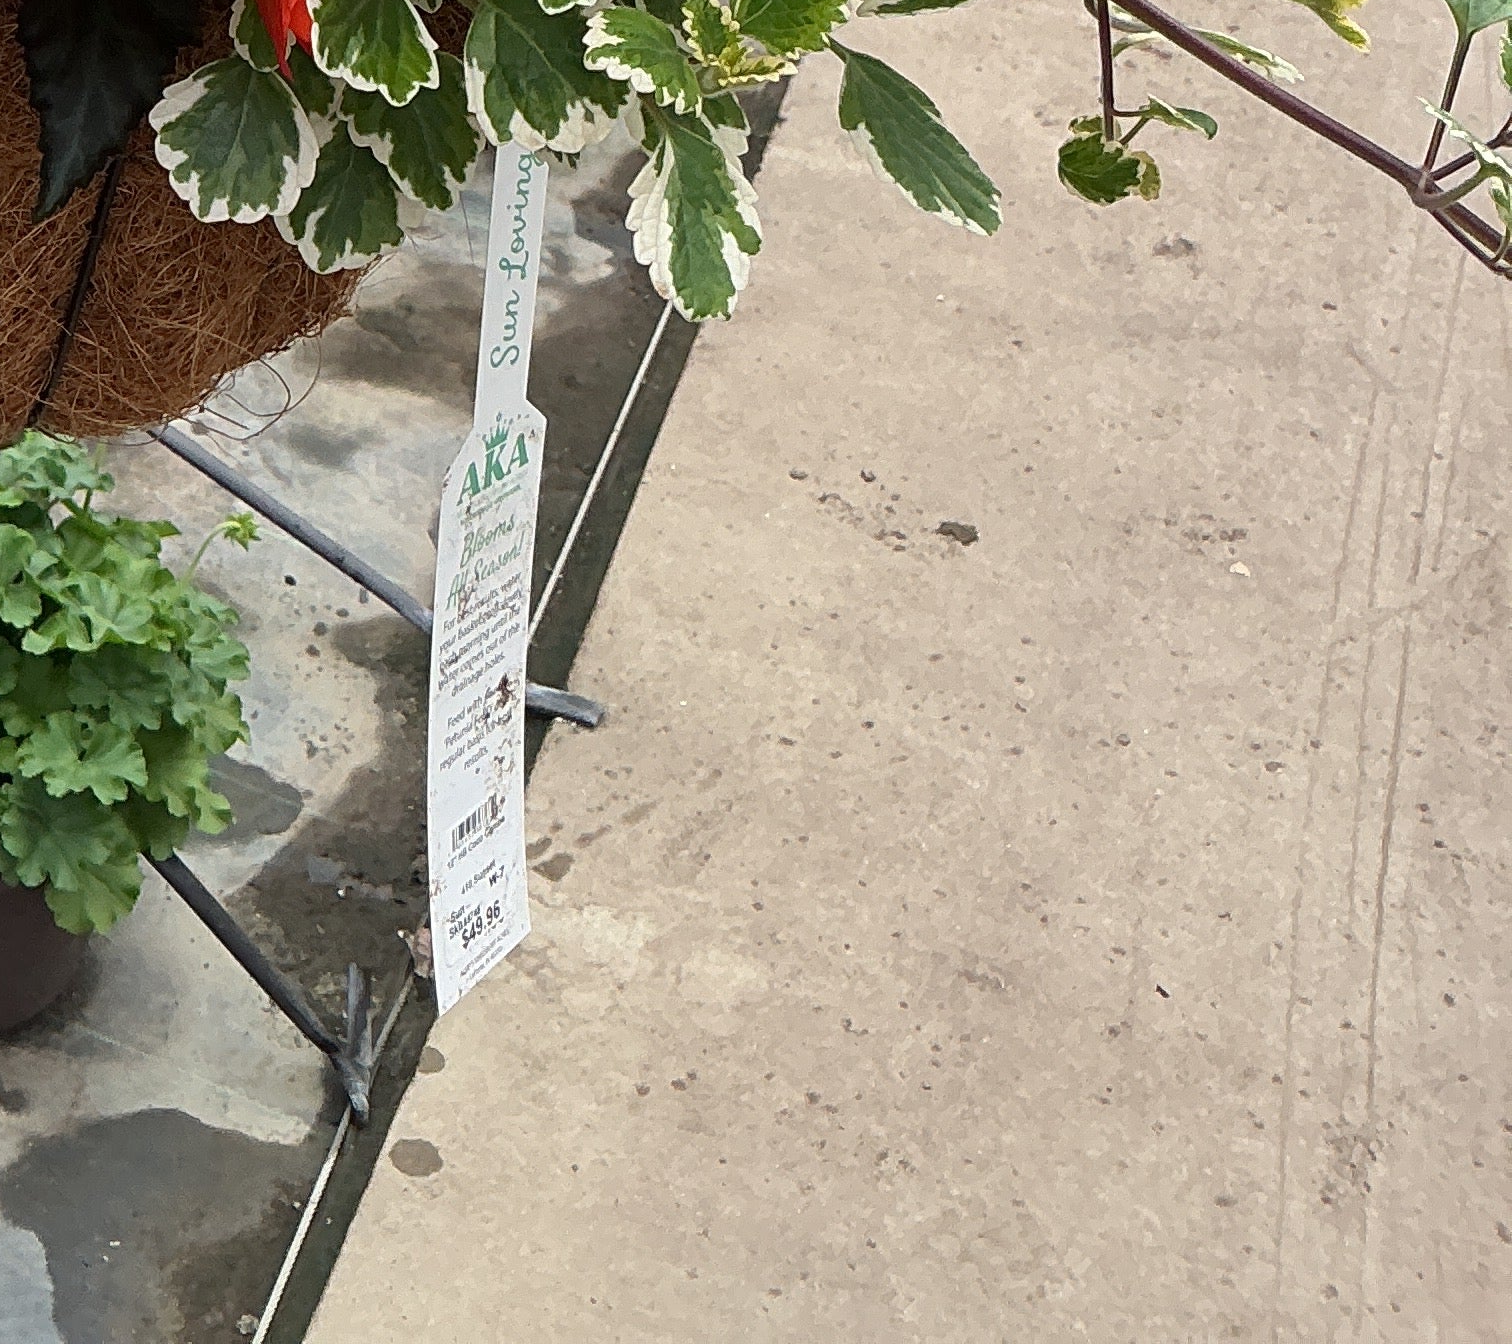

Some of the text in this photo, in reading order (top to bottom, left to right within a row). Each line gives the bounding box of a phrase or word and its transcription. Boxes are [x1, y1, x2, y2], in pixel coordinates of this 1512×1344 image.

[490, 150, 545, 369] Sun Loving
[456, 432, 529, 507] AKA
[459, 514, 515, 569] Blooms
[474, 531, 525, 585] Season!
[447, 706, 464, 730] Feed
[462, 899, 500, 943] $49.96
